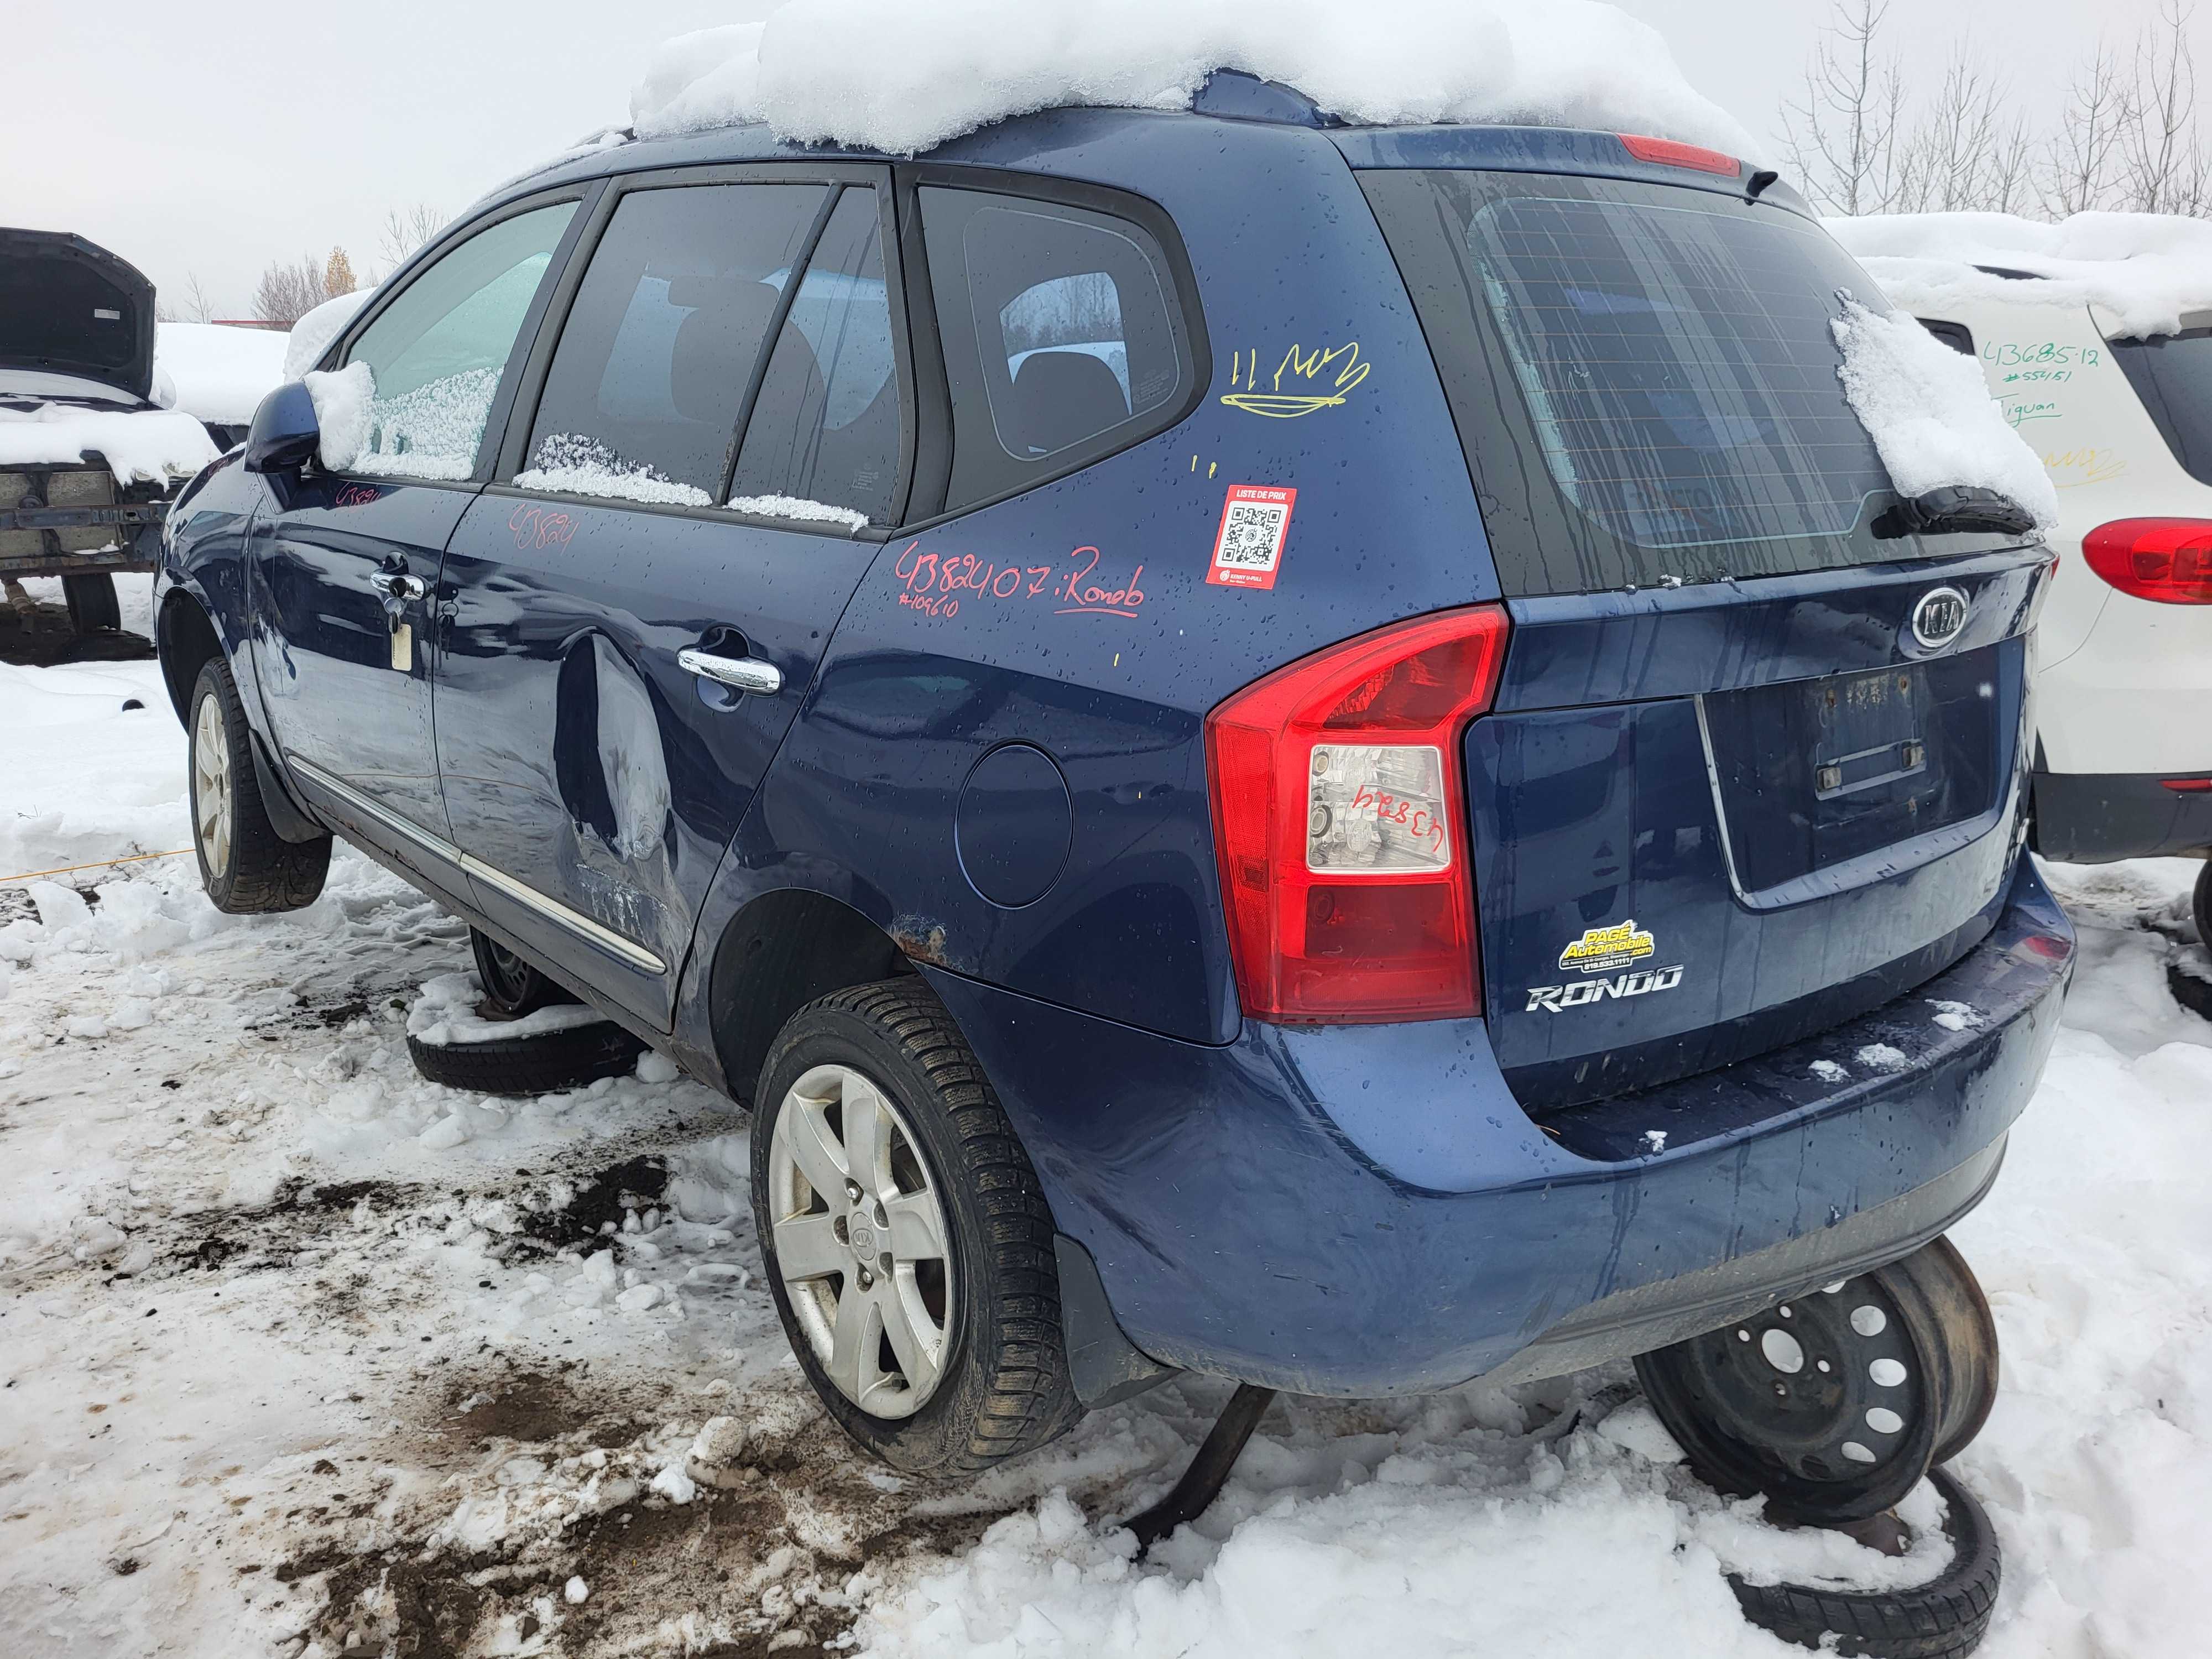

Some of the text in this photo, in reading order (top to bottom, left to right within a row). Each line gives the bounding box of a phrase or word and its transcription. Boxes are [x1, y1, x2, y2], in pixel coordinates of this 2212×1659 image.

[1237, 489, 1286, 500] LISTE DE PRIX
[1924, 601, 1959, 635] KIA
[1585, 924, 1630, 945] PAGÉ
[1564, 935, 1651, 959] Automobile
[1584, 957, 1630, 970] 819.533.1111
[1525, 964, 1684, 1013] RONDO
